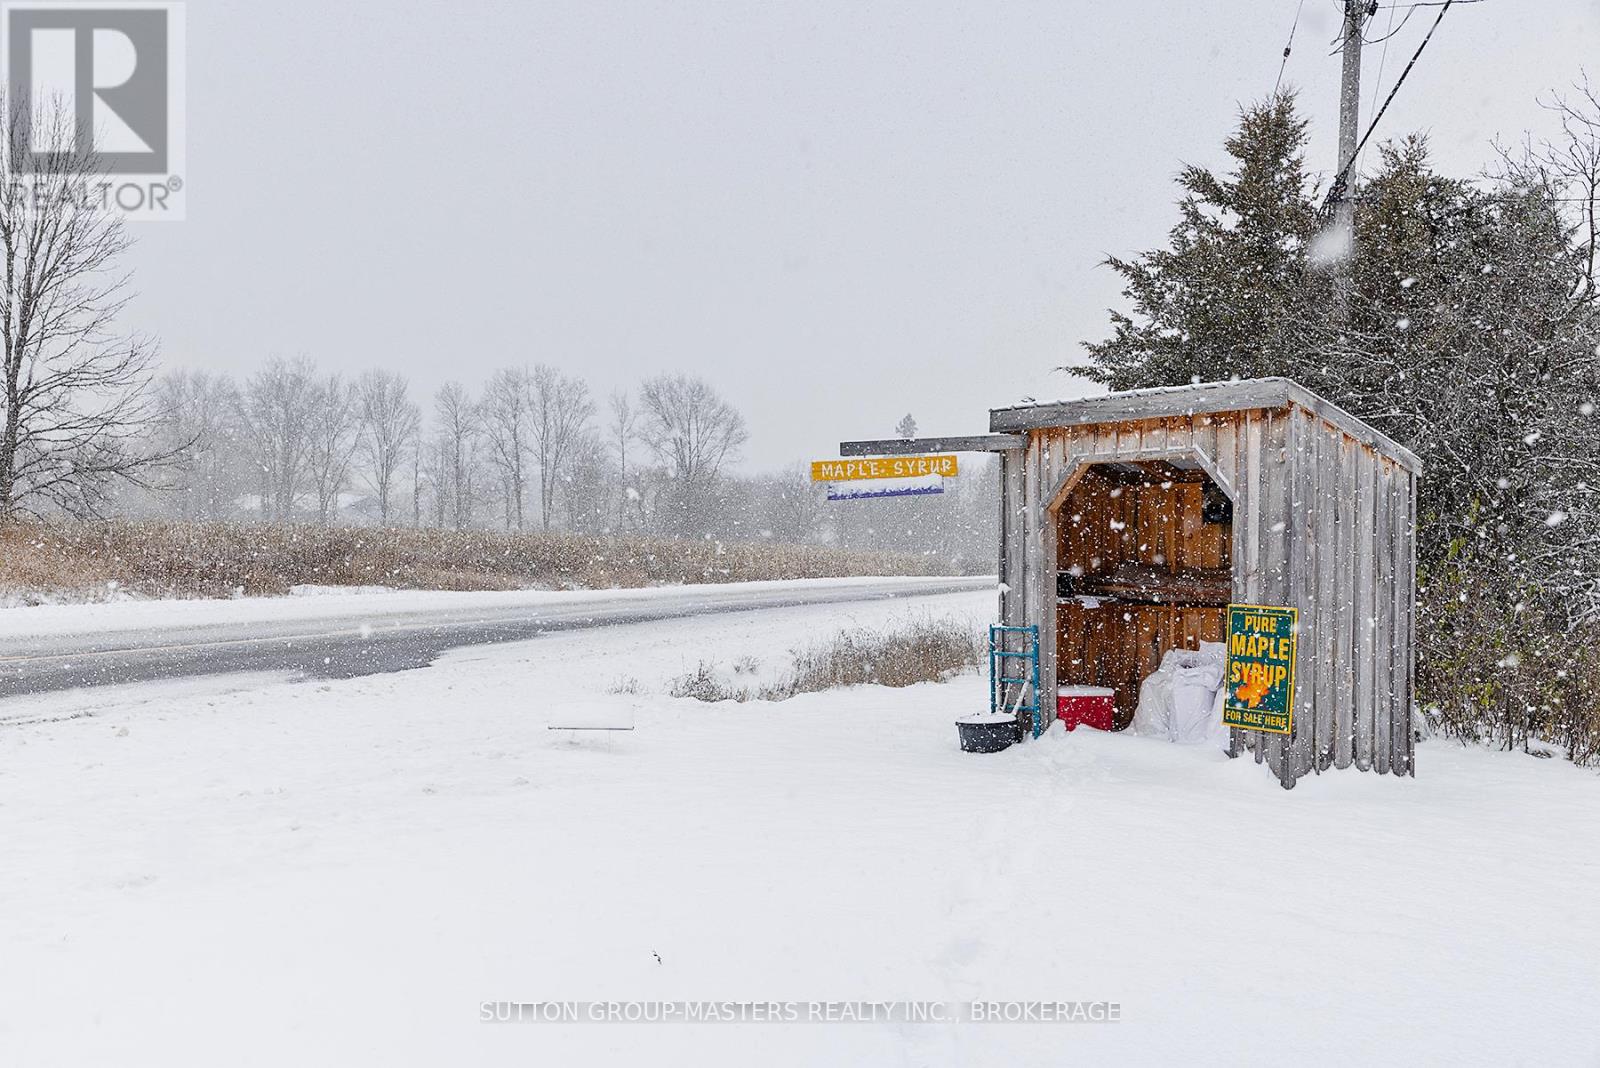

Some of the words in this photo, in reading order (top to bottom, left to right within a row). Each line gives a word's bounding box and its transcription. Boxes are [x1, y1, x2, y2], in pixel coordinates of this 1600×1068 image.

[1245, 615, 1277, 633] PURE
[1231, 634, 1289, 660] MAPLE
[1231, 661, 1287, 690] SYRUP
[1225, 710, 1241, 721] FOR
[1243, 712, 1263, 724] SALE
[1264, 714, 1287, 727] HERE
